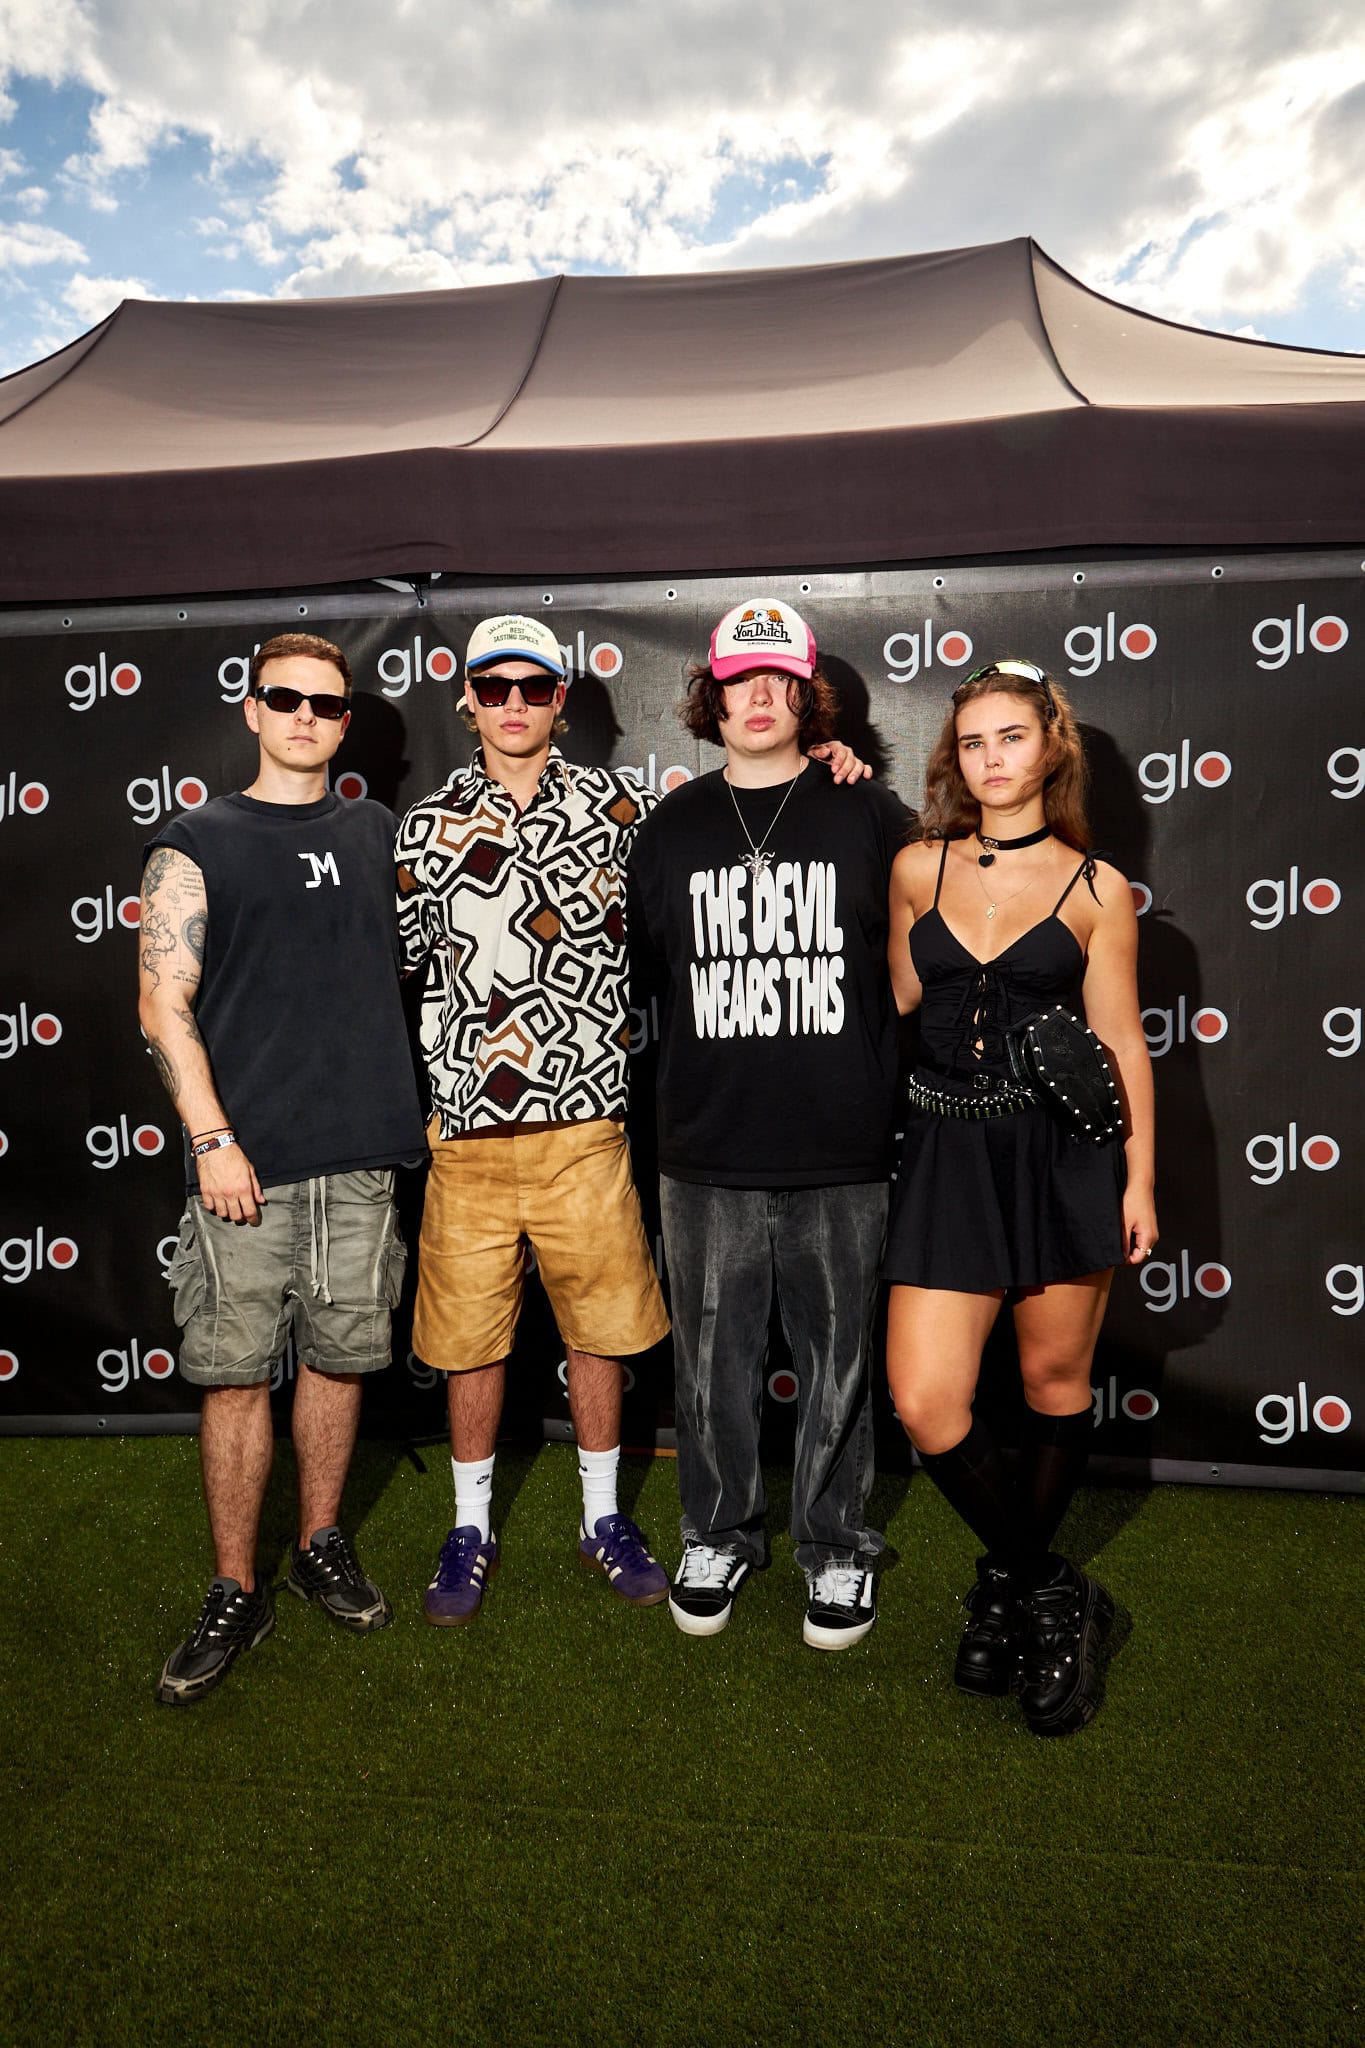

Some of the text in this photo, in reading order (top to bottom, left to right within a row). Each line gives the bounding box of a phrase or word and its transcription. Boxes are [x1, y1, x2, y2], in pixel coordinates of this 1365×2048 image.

[734, 622, 789, 641] Von Dutch
[883, 619, 974, 683] glo
[1064, 611, 1157, 677] glo
[1252, 604, 1349, 670] glo
[64, 651, 142, 711] glo
[377, 635, 457, 697] glo
[0, 771, 49, 823] lo
[126, 765, 208, 825] glo
[1138, 738, 1232, 804] glo
[71, 884, 140, 943] glo
[689, 861, 843, 958] THE DEVIL
[1246, 865, 1341, 930] glo
[690, 955, 845, 1039] WEARS THIS
[1140, 995, 1228, 1058] glo
[86, 1113, 165, 1170] glo
[1246, 1122, 1340, 1185] glo
[0, 1226, 79, 1284] glo
[1139, 1249, 1232, 1312] glo
[97, 1337, 175, 1393] glo
[1255, 1381, 1352, 1445] glo
